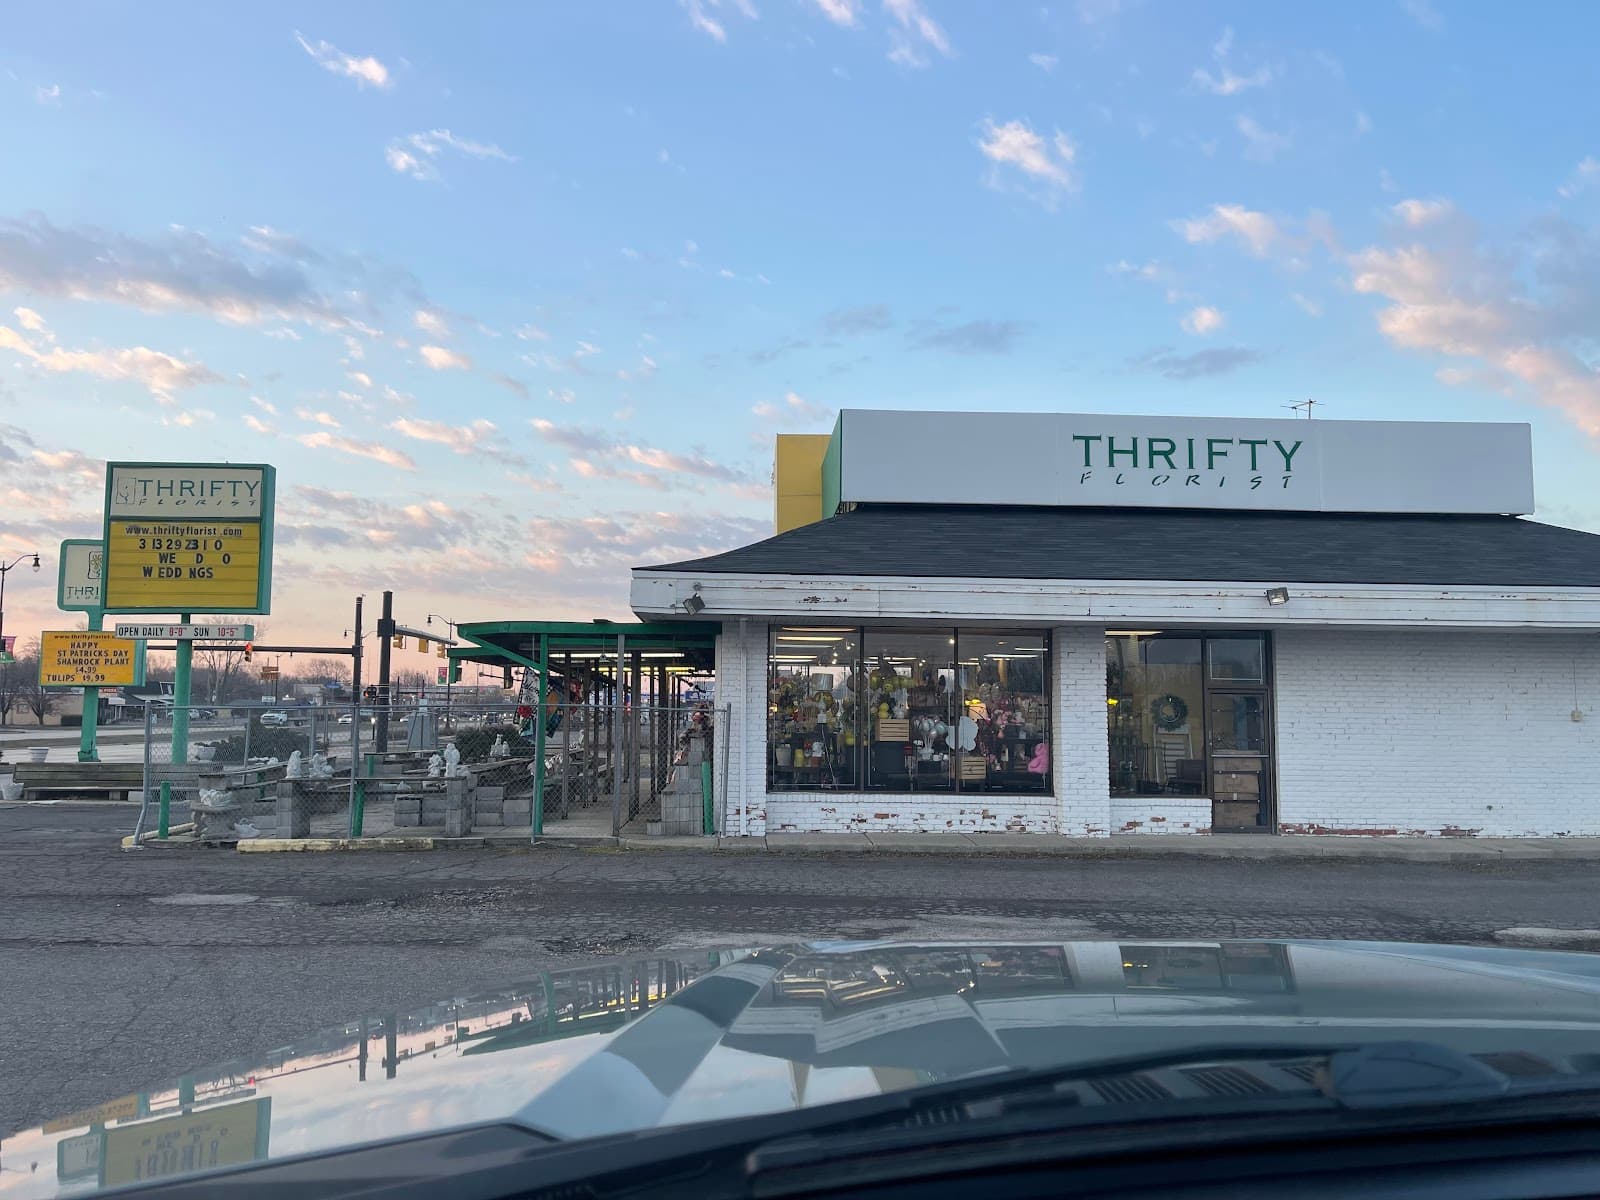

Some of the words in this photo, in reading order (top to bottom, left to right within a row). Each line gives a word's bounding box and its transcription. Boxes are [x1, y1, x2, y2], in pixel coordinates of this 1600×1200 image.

[1073, 433, 1303, 472] THRIFTY
[1080, 471, 1292, 490] FLORIST
[137, 479, 260, 498] THRIFTY
[138, 498, 257, 506] FLORIST
[158, 552, 176, 564] WE
[66, 586, 99, 596] THRI
[118, 626, 139, 637] OPEN
[142, 626, 164, 637] DAILY
[193, 627, 210, 637] SUN
[70, 641, 98, 649] HAPPY
[57, 649, 66, 657] ST
[70, 649, 109, 657] PATRICKS
[113, 649, 129, 657] DAY
[56, 658, 100, 666] SHAMROCK
[47, 674, 76, 682] TULIPS
